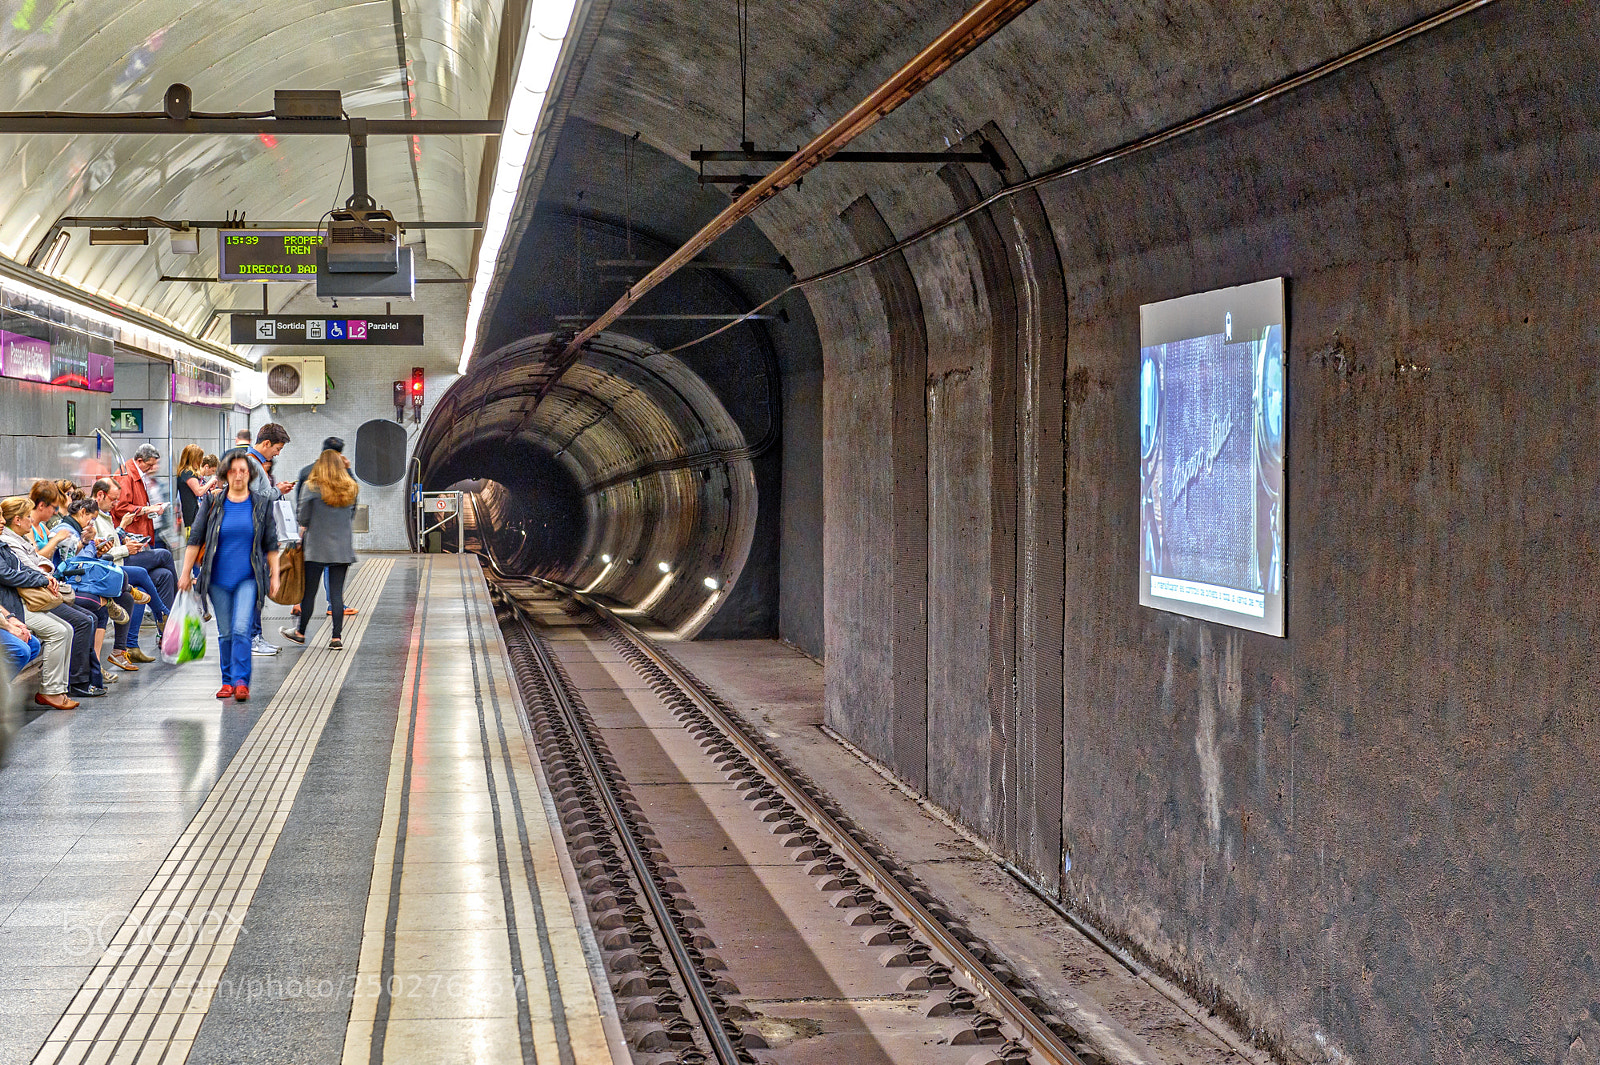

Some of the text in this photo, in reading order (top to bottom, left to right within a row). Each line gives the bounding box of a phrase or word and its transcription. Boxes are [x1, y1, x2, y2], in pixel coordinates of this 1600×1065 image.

[226, 236, 324, 245] 15:39 PROPER
[284, 245, 311, 255] TREN
[277, 322, 305, 330] Sortida
[349, 327, 366, 338] L2
